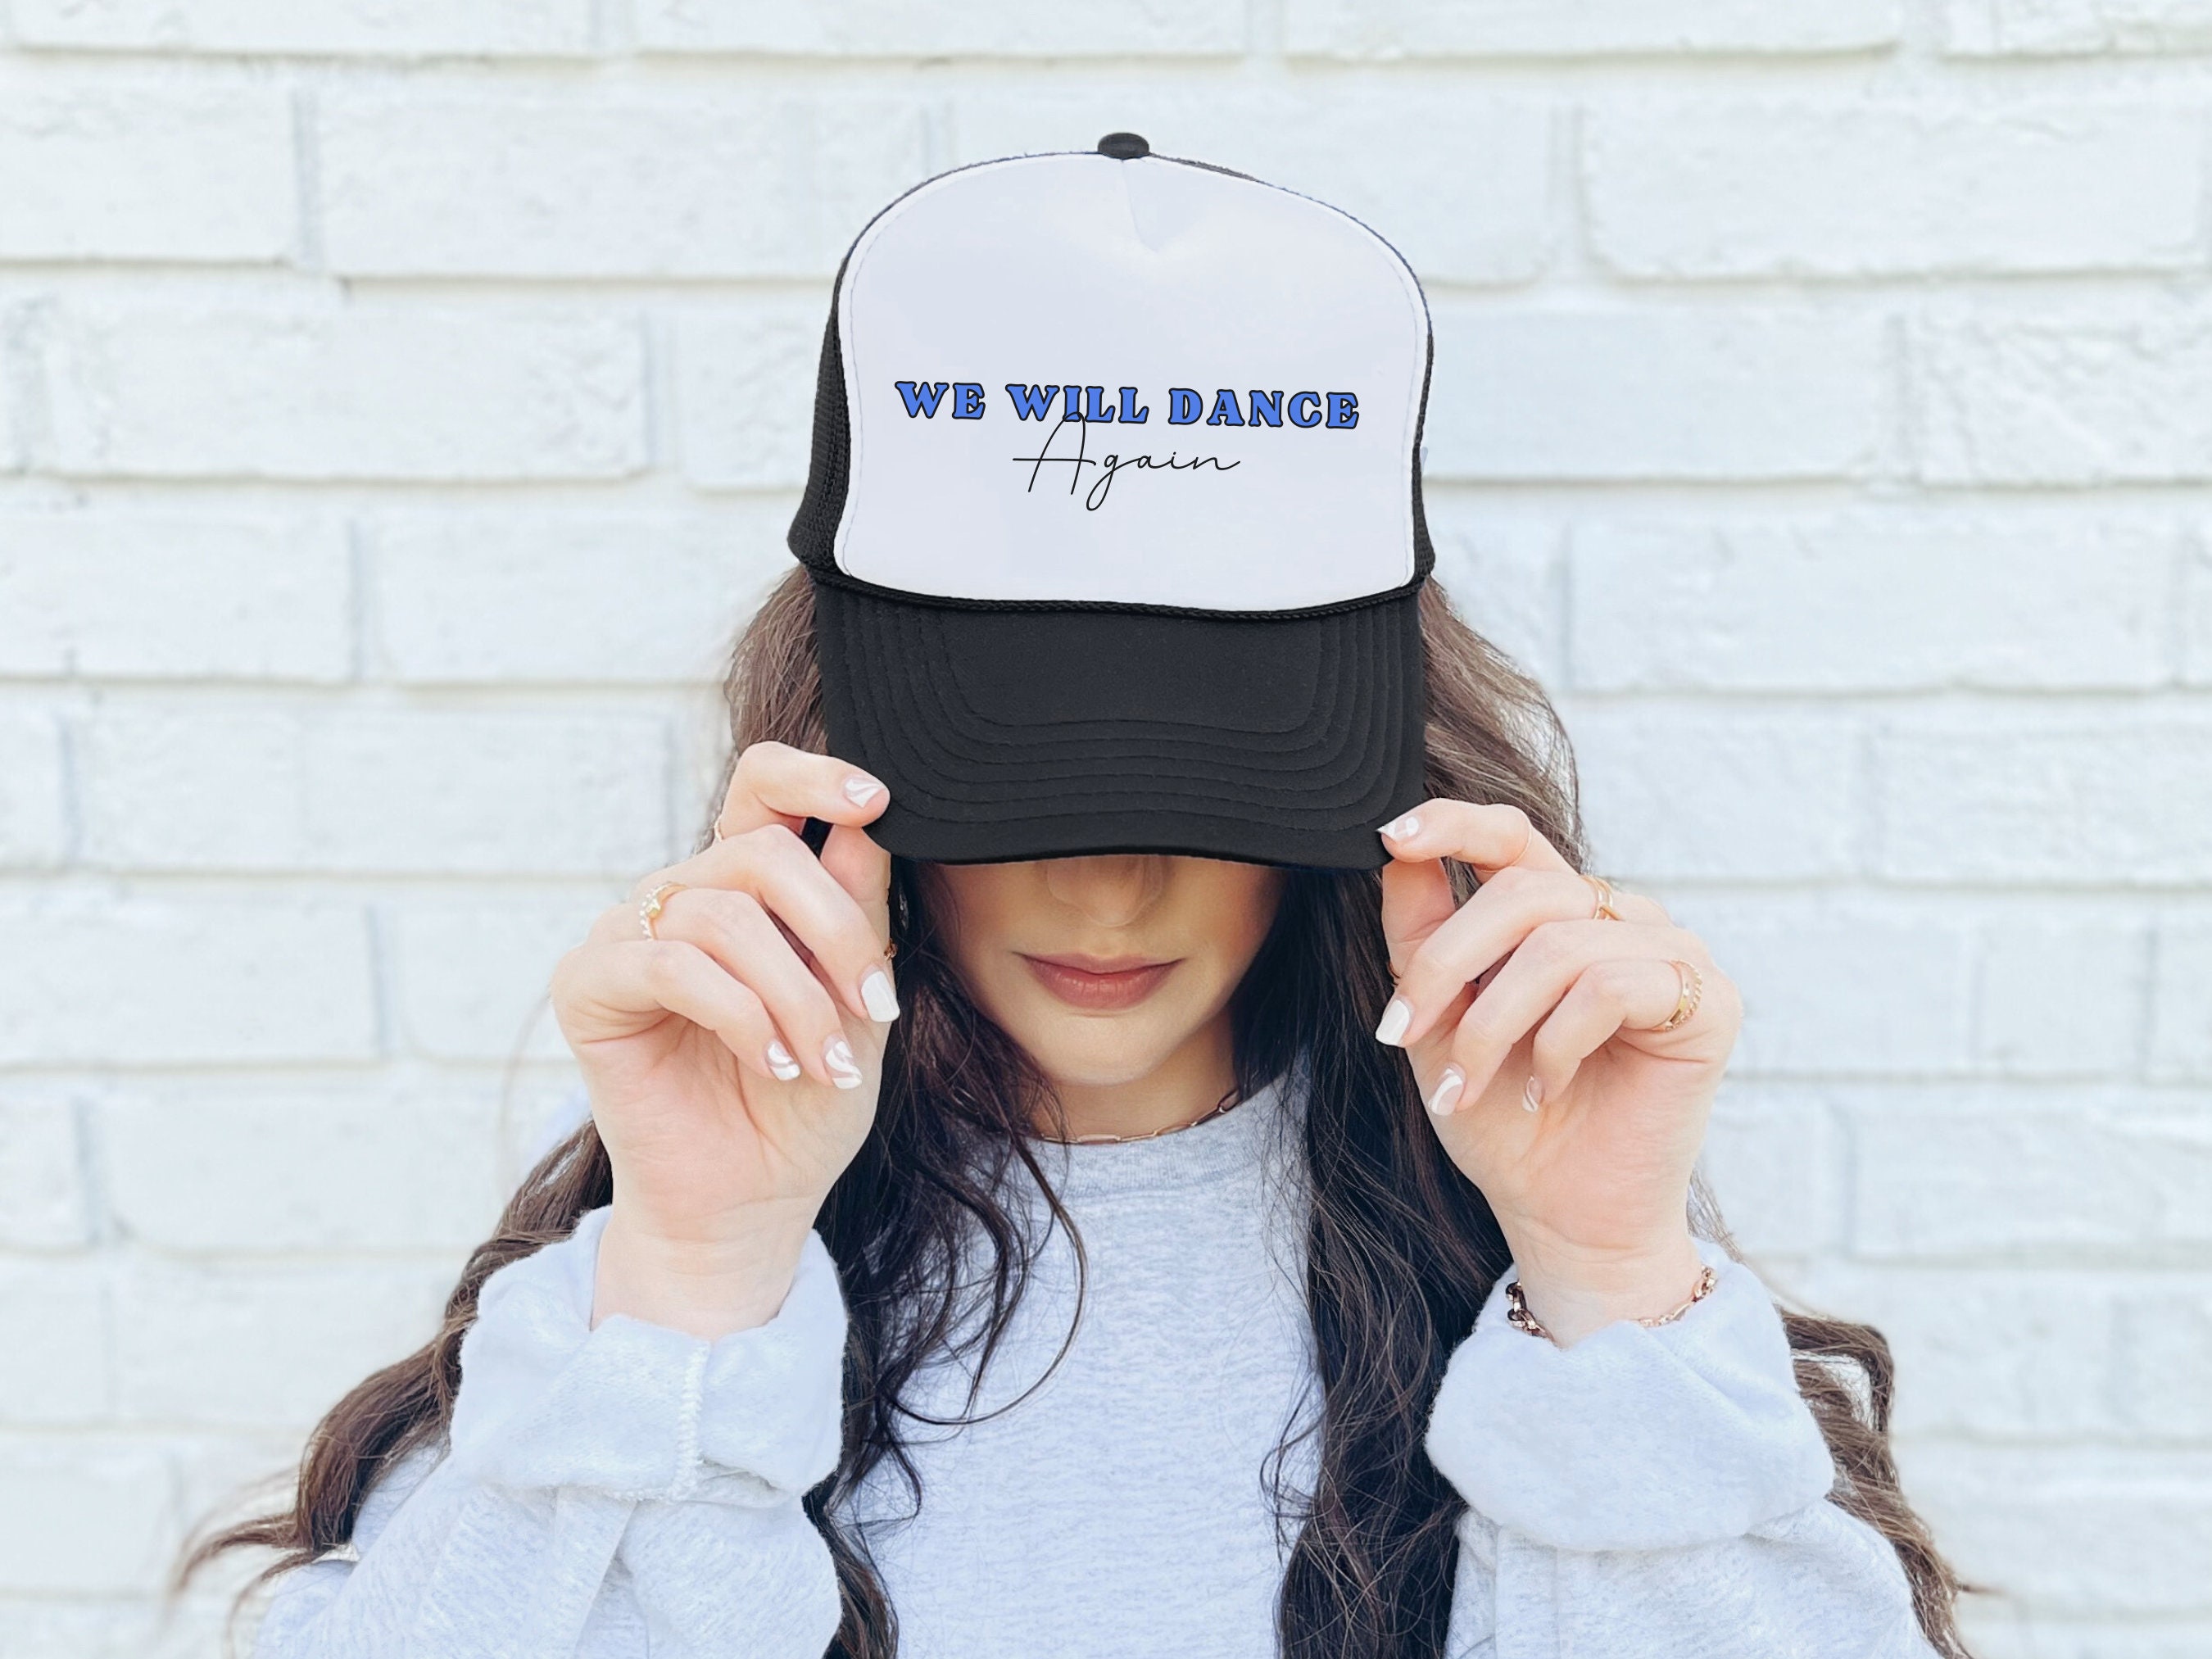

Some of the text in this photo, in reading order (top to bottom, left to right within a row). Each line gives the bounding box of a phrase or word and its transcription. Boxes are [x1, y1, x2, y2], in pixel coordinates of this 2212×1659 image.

[895, 381, 1359, 429] WE WILL DANCE
[1013, 411, 1240, 510] Again
